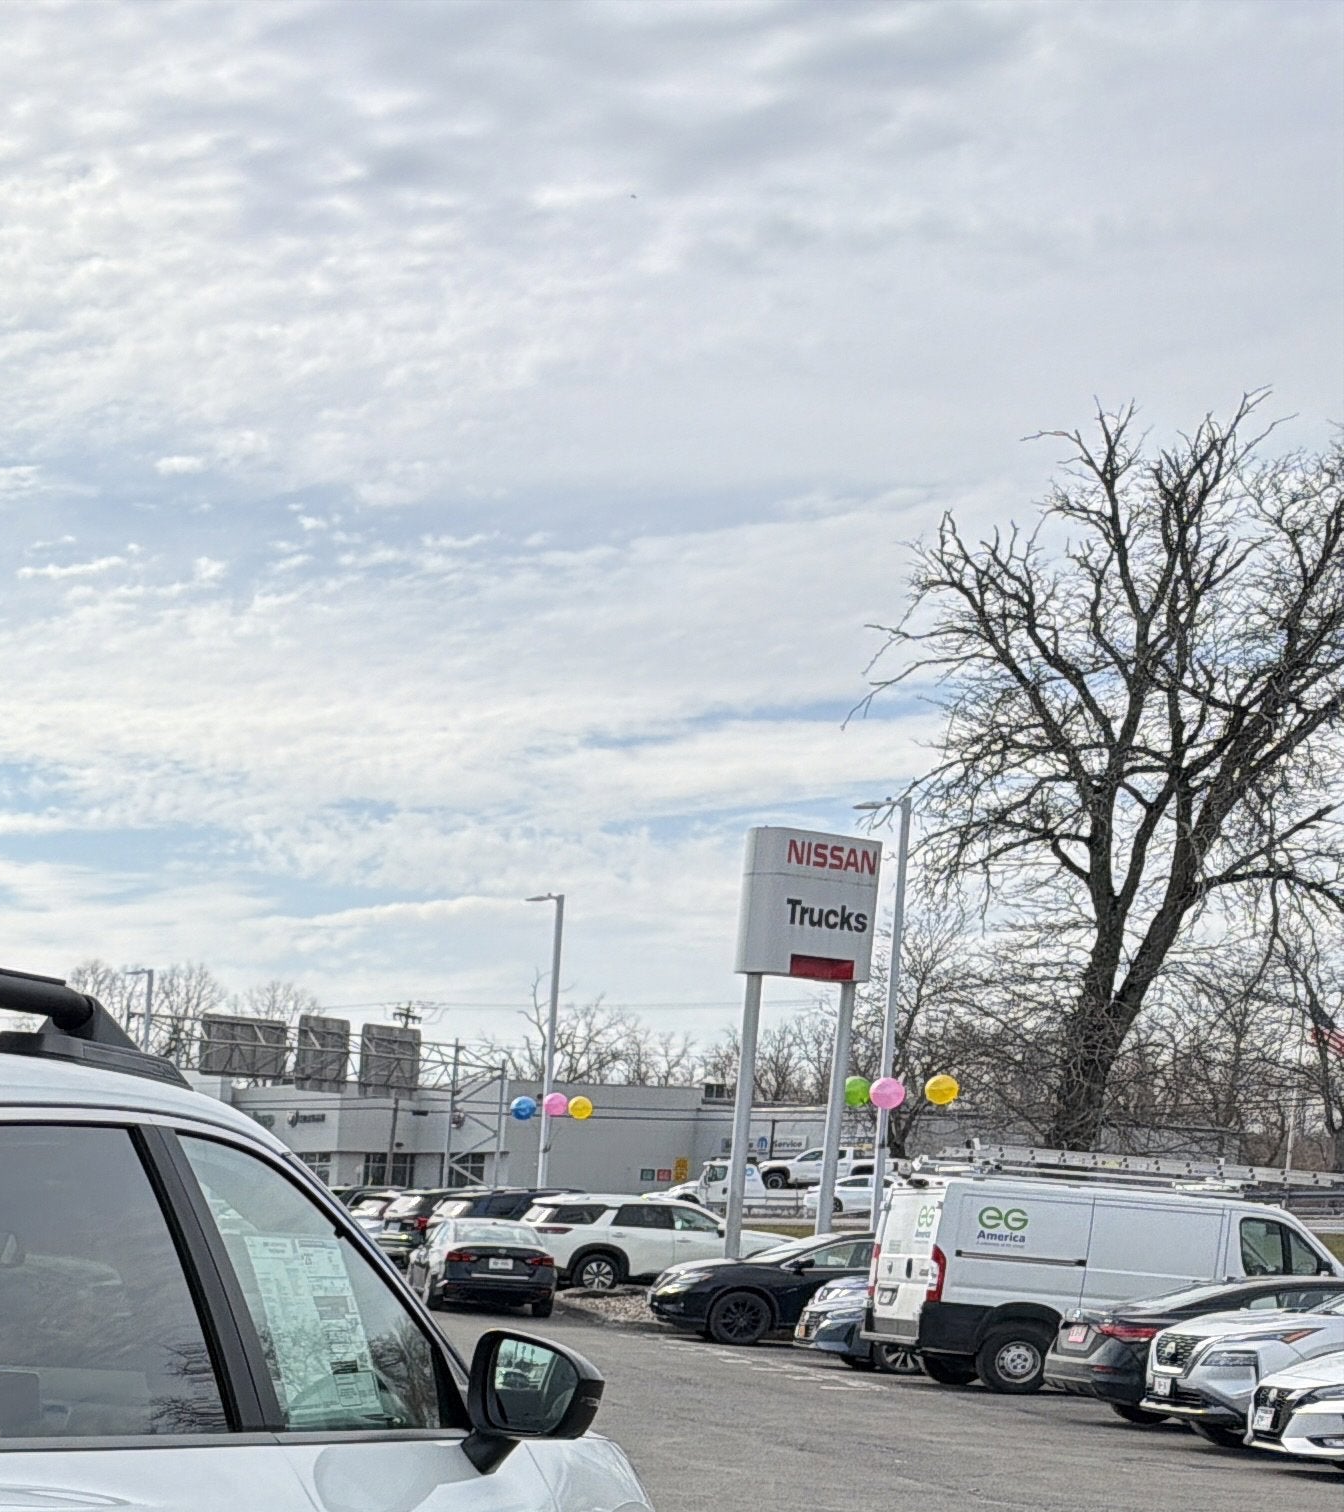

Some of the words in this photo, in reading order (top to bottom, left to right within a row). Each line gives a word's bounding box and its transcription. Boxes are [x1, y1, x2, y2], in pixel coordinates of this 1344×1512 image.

[787, 839, 877, 876] NISSAN
[787, 898, 868, 933] Trucks
[977, 1230, 1026, 1243] America
